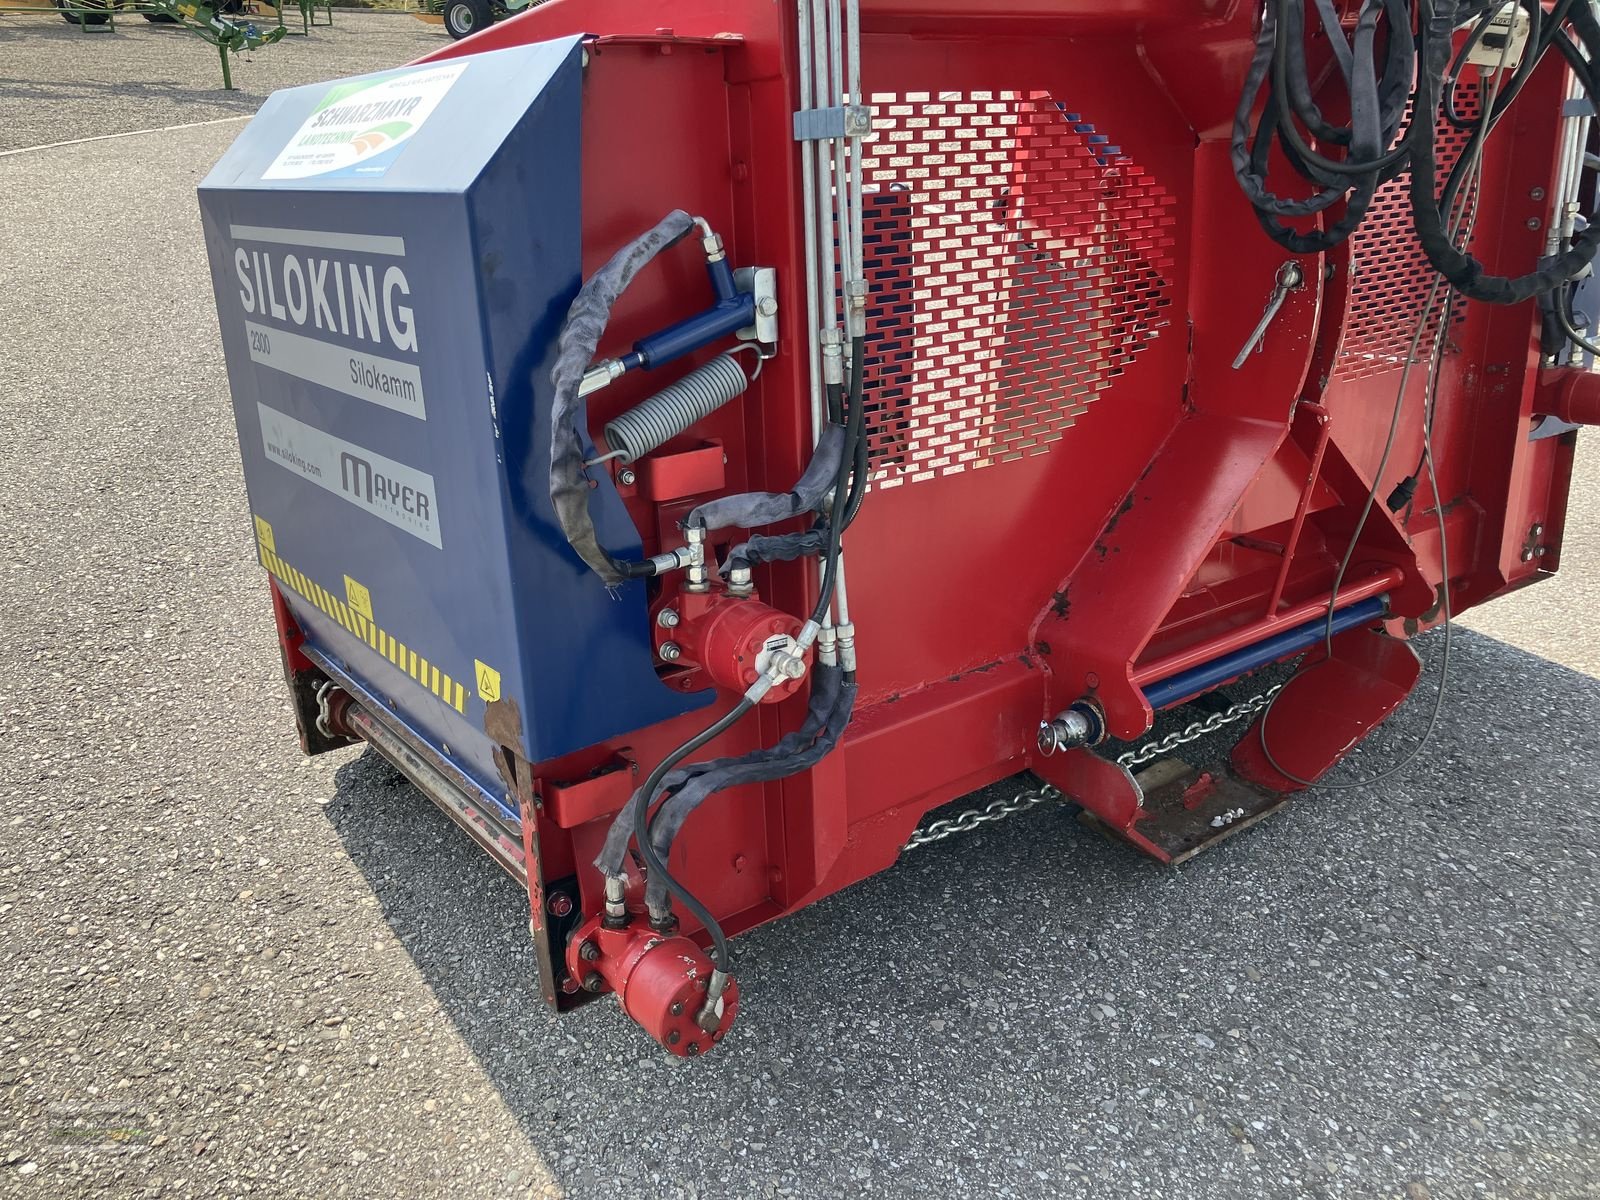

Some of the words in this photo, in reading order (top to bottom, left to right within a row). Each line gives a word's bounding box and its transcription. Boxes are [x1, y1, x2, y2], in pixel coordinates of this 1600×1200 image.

[311, 96, 422, 128] SCHWARZMAYR
[234, 247, 419, 353] SILOKING
[251, 330, 271, 355] 2300
[349, 357, 416, 402] Silokamm
[267, 441, 322, 478] www.siloking.com
